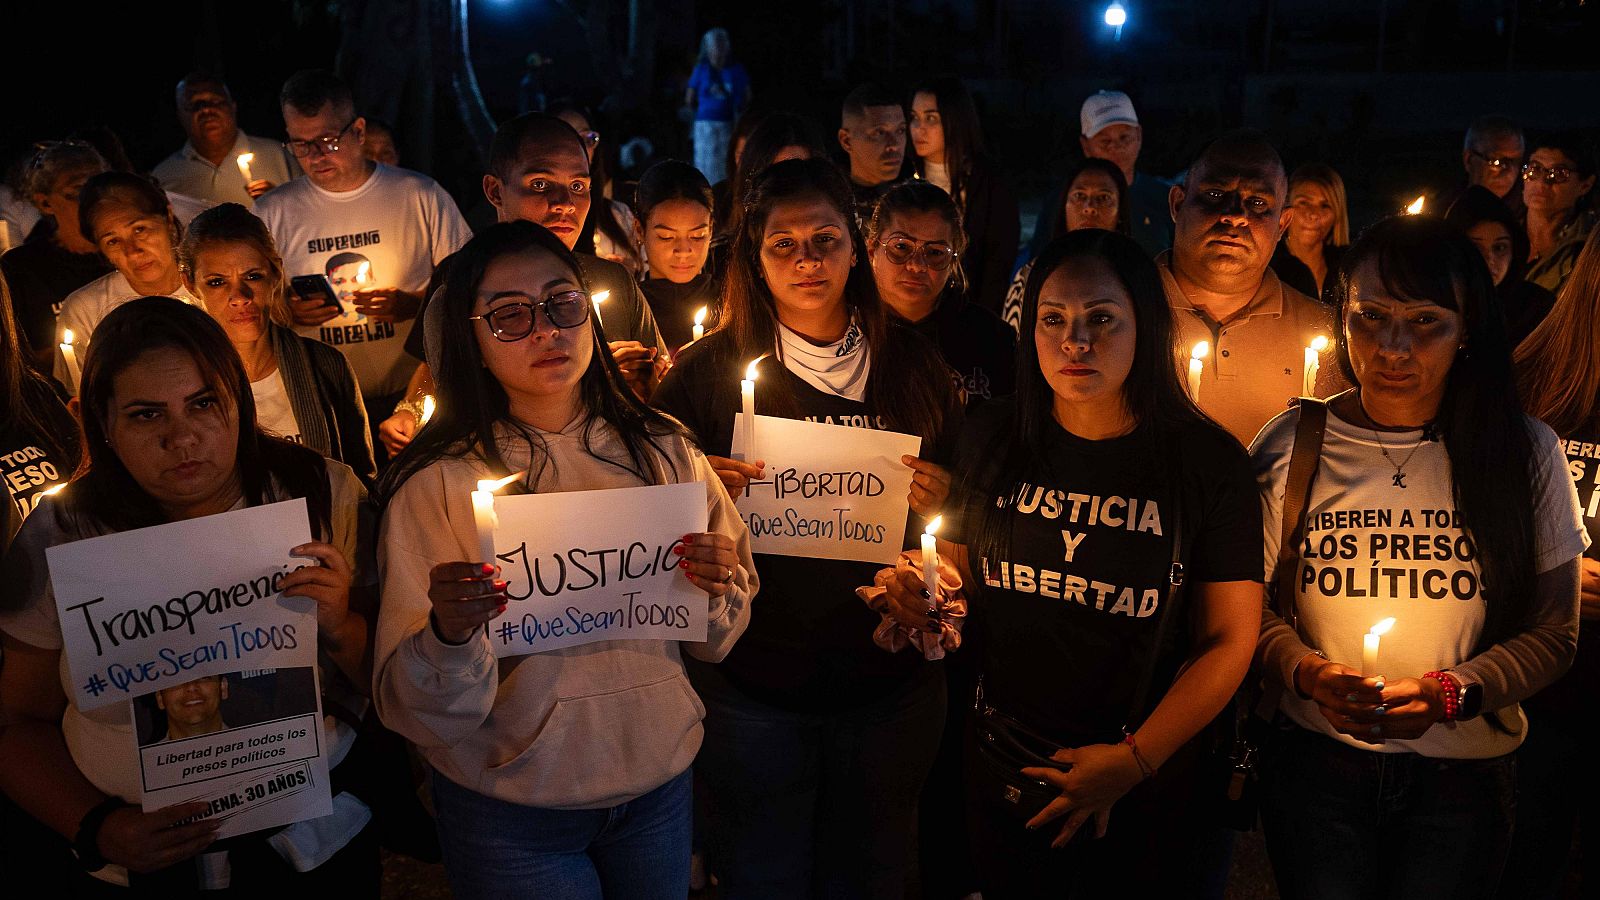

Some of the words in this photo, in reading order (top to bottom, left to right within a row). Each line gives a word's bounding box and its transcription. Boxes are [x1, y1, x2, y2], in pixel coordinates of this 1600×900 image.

[997, 482, 1163, 536] USTICIA
[1399, 509, 1415, 528] A
[1061, 530, 1088, 562] Y
[1303, 534, 1358, 560] LOS
[981, 556, 1159, 618] LIBERTAD
[157, 747, 212, 766] Libertad
[215, 741, 244, 757] para
[248, 732, 284, 748] todos
[287, 728, 306, 740] los
[182, 761, 228, 778] presos
[231, 746, 286, 768] políticos
[245, 784, 266, 802] 30
[268, 770, 307, 794] AÑOS
